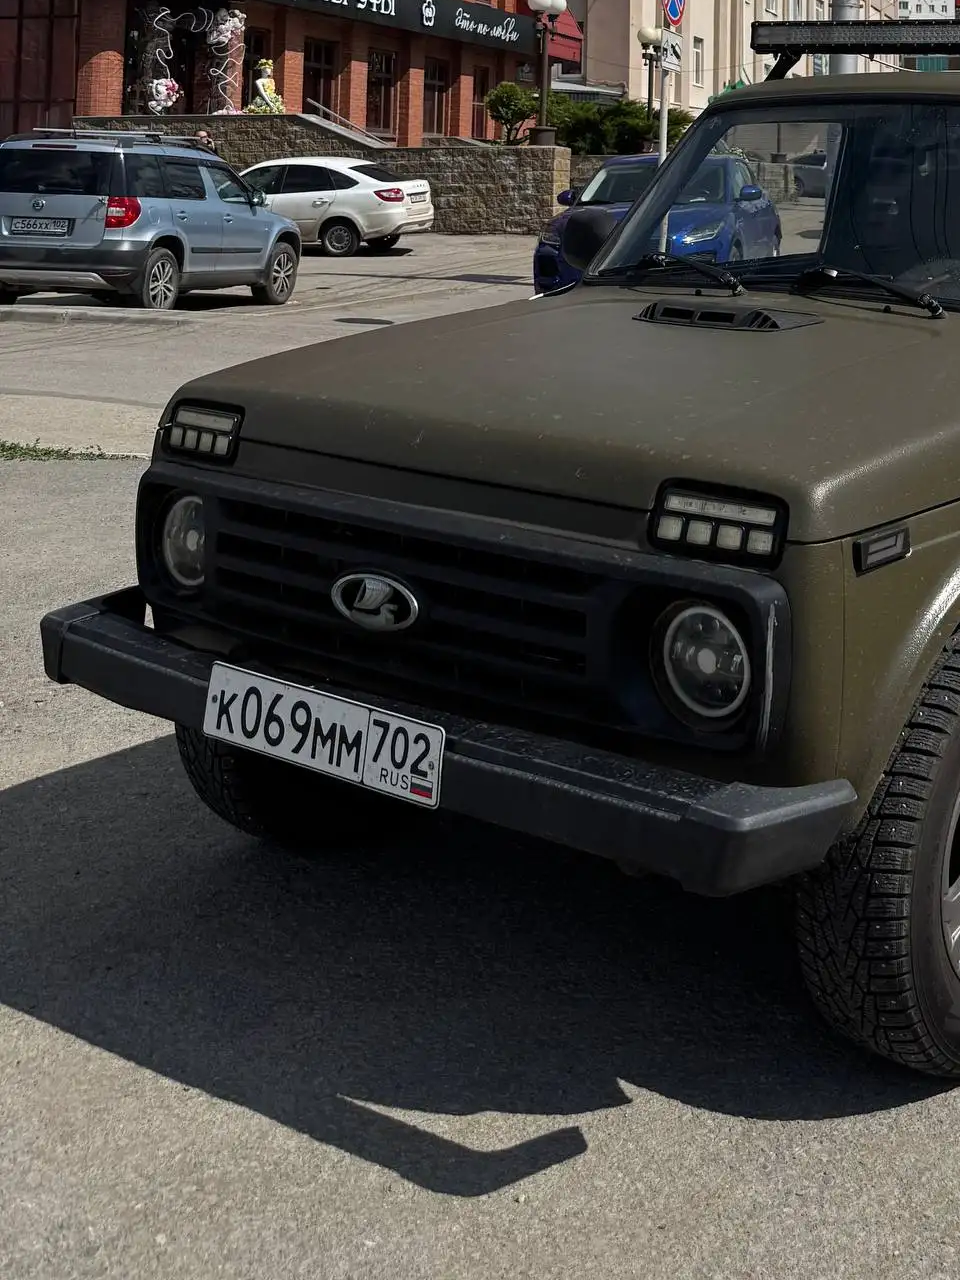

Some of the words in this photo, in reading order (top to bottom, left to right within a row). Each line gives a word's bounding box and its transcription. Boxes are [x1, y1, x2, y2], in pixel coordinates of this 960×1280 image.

[455, 7, 478, 32] Это
[477, 23, 491, 36] по
[215, 686, 363, 773] К069ММ
[372, 718, 431, 778] 702
[379, 767, 410, 791] RUS
